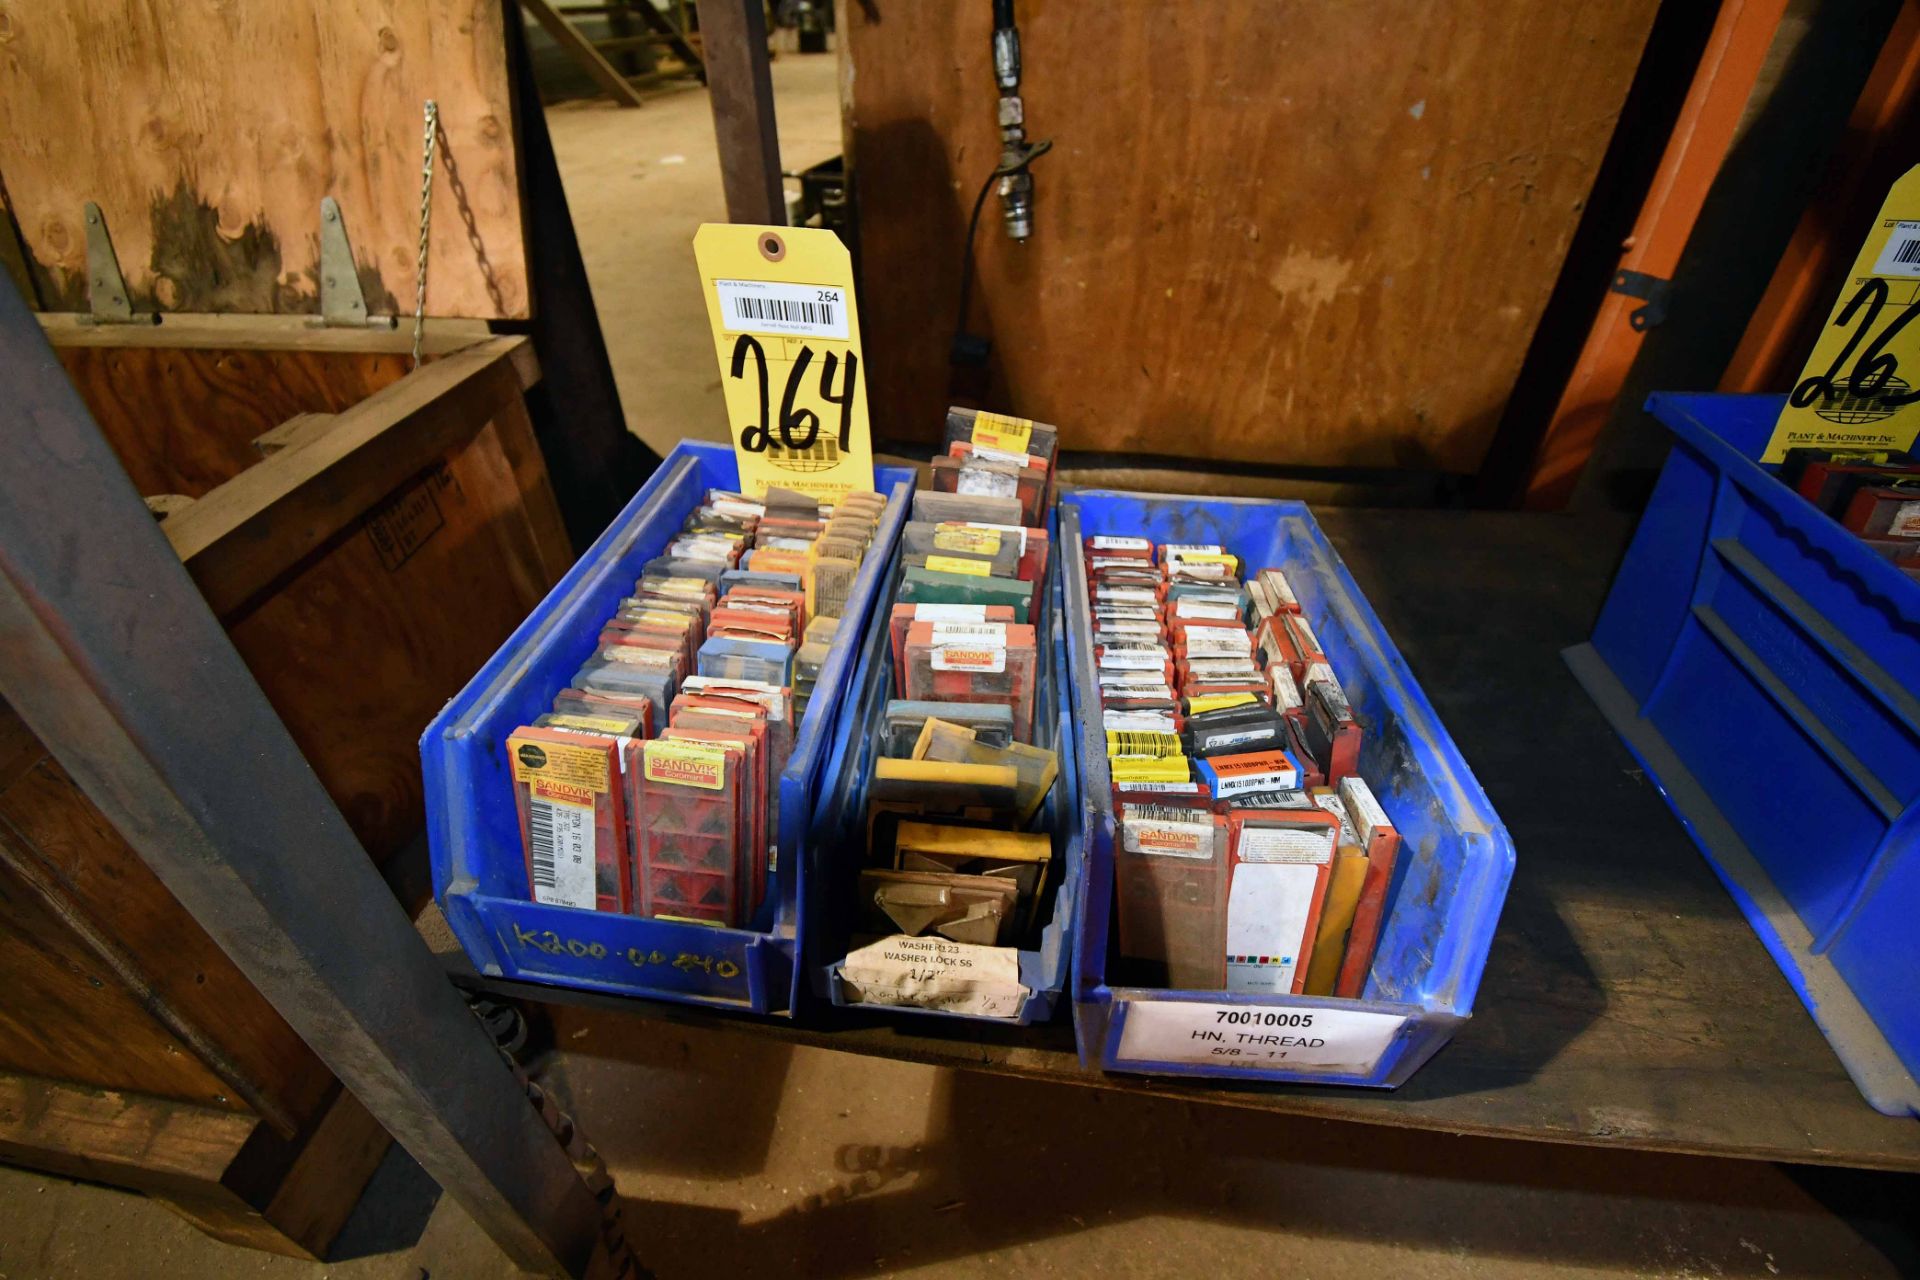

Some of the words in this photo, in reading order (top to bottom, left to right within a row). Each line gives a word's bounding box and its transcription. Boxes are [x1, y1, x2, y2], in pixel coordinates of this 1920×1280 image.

[817, 290, 839, 303] 264
[1790, 277, 1920, 408] 26
[730, 333, 858, 454] 264
[651, 758, 717, 776] SANDVIK
[664, 770, 704, 782] Coromant
[536, 778, 592, 799] SANDVIK
[1139, 830, 1197, 841] SANDVIK
[884, 952, 927, 963] WASHER
[930, 955, 956, 967] LOCK
[1216, 1011, 1313, 1028] 70010005
[1236, 1033, 1325, 1049] THREAD
[1210, 1047, 1241, 1057] 5/8
